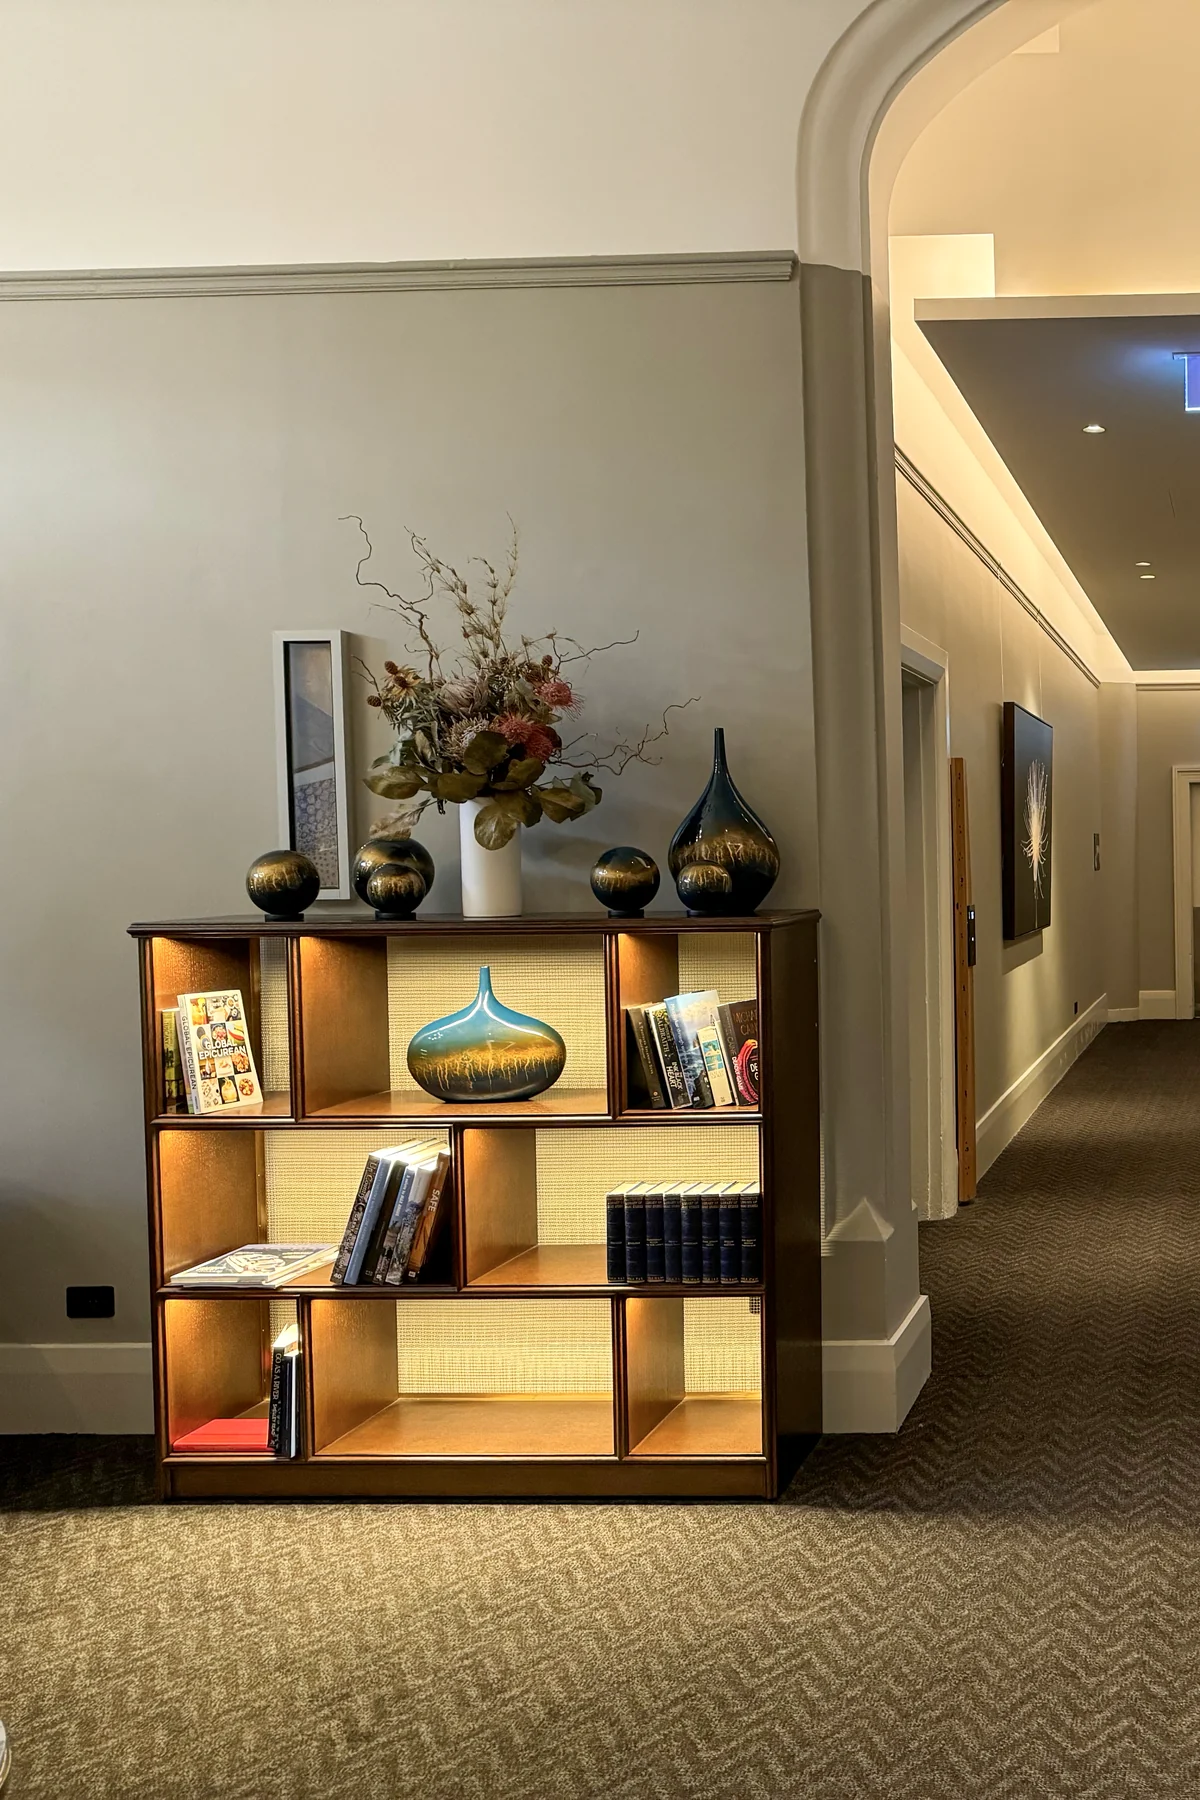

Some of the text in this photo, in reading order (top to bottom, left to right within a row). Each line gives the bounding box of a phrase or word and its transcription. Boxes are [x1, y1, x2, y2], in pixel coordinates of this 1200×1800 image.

[734, 1010, 757, 1023] MICHA
[182, 1016, 190, 1044] GLOBAL
[740, 1022, 758, 1036] CAIN
[205, 1040, 238, 1050] GLOBAL
[199, 1046, 246, 1060] EPICUREAN
[186, 1046, 198, 1090] EPICUREAN
[666, 1066, 677, 1088] HEART
[428, 1188, 440, 1212] SAFE
[275, 1352, 281, 1363] GO
